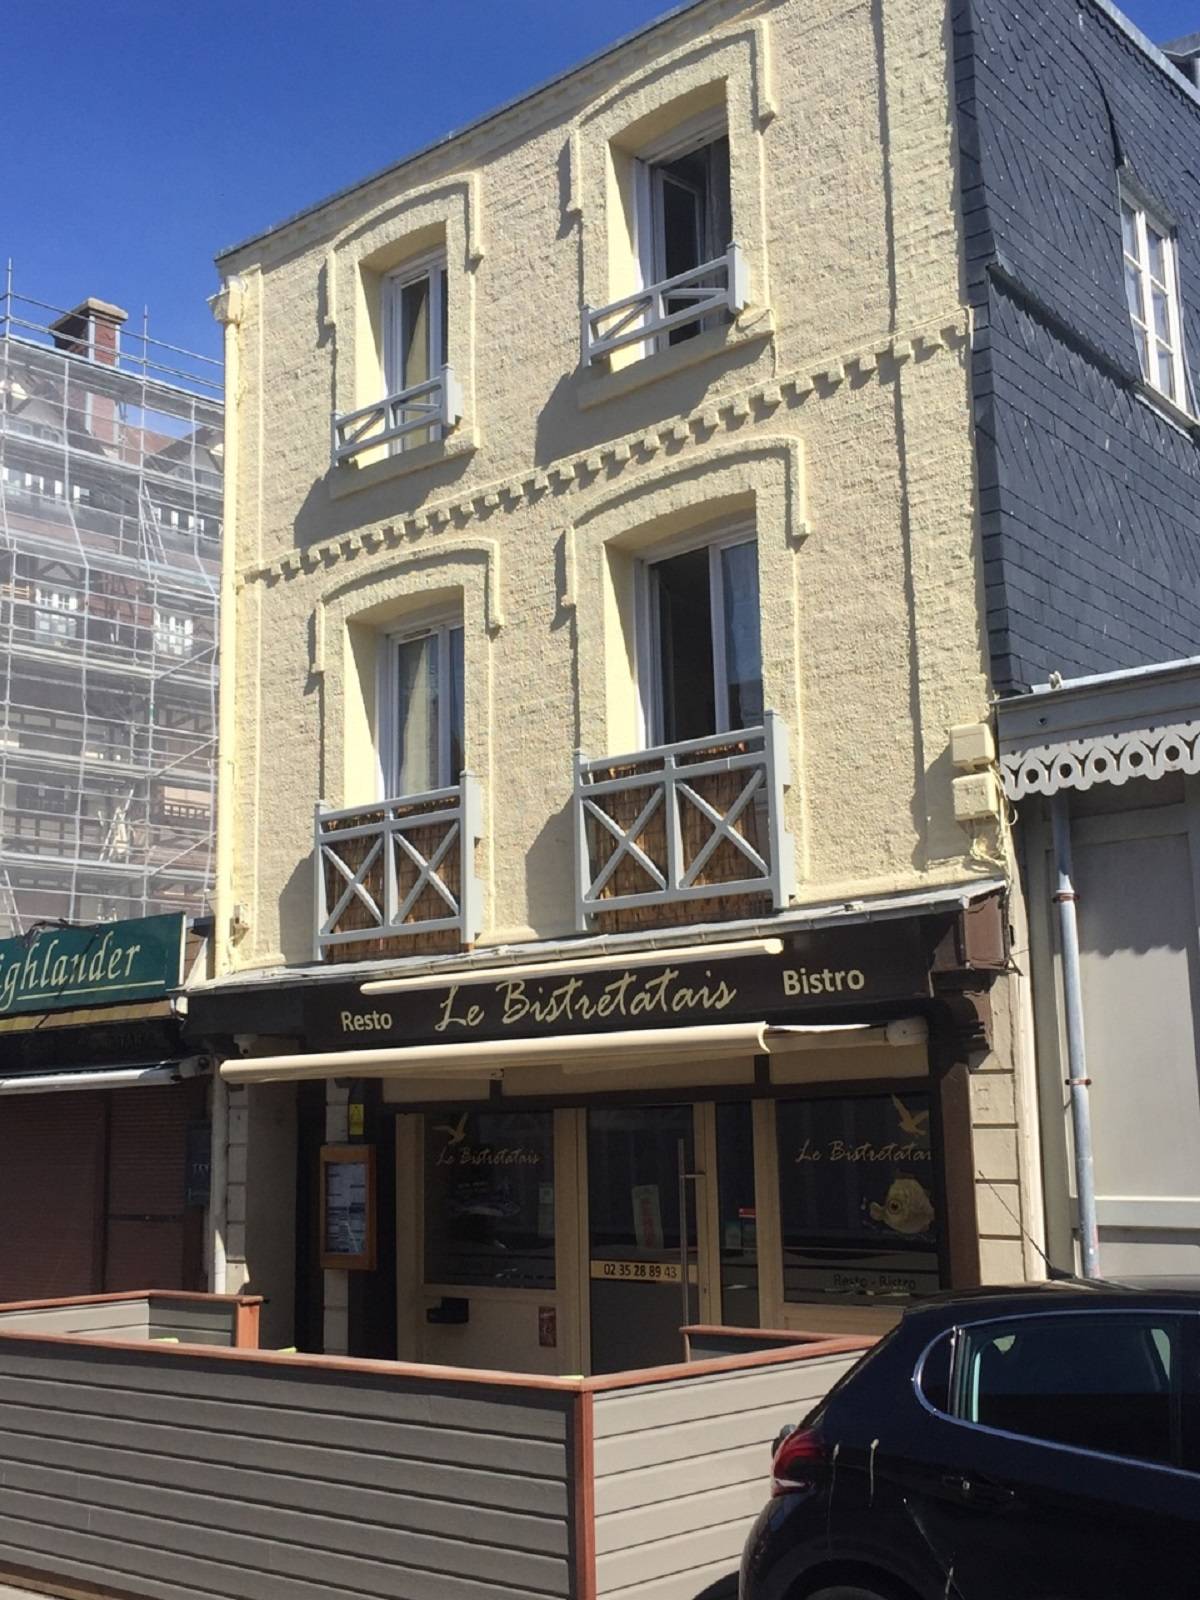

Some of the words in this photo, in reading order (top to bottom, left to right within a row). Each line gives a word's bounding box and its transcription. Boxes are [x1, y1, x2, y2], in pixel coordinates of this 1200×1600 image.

[782, 968, 865, 996] Bistro
[434, 984, 485, 1032] Le
[495, 967, 737, 1025] Bistretatais
[340, 1010, 393, 1032] Resto
[435, 1145, 455, 1166] Le
[795, 1139, 821, 1163] Le
[603, 1263, 616, 1276] 02
[619, 1263, 631, 1276] 35
[633, 1264, 646, 1277] 28
[648, 1264, 661, 1278] 89
[663, 1265, 677, 1279] 43
